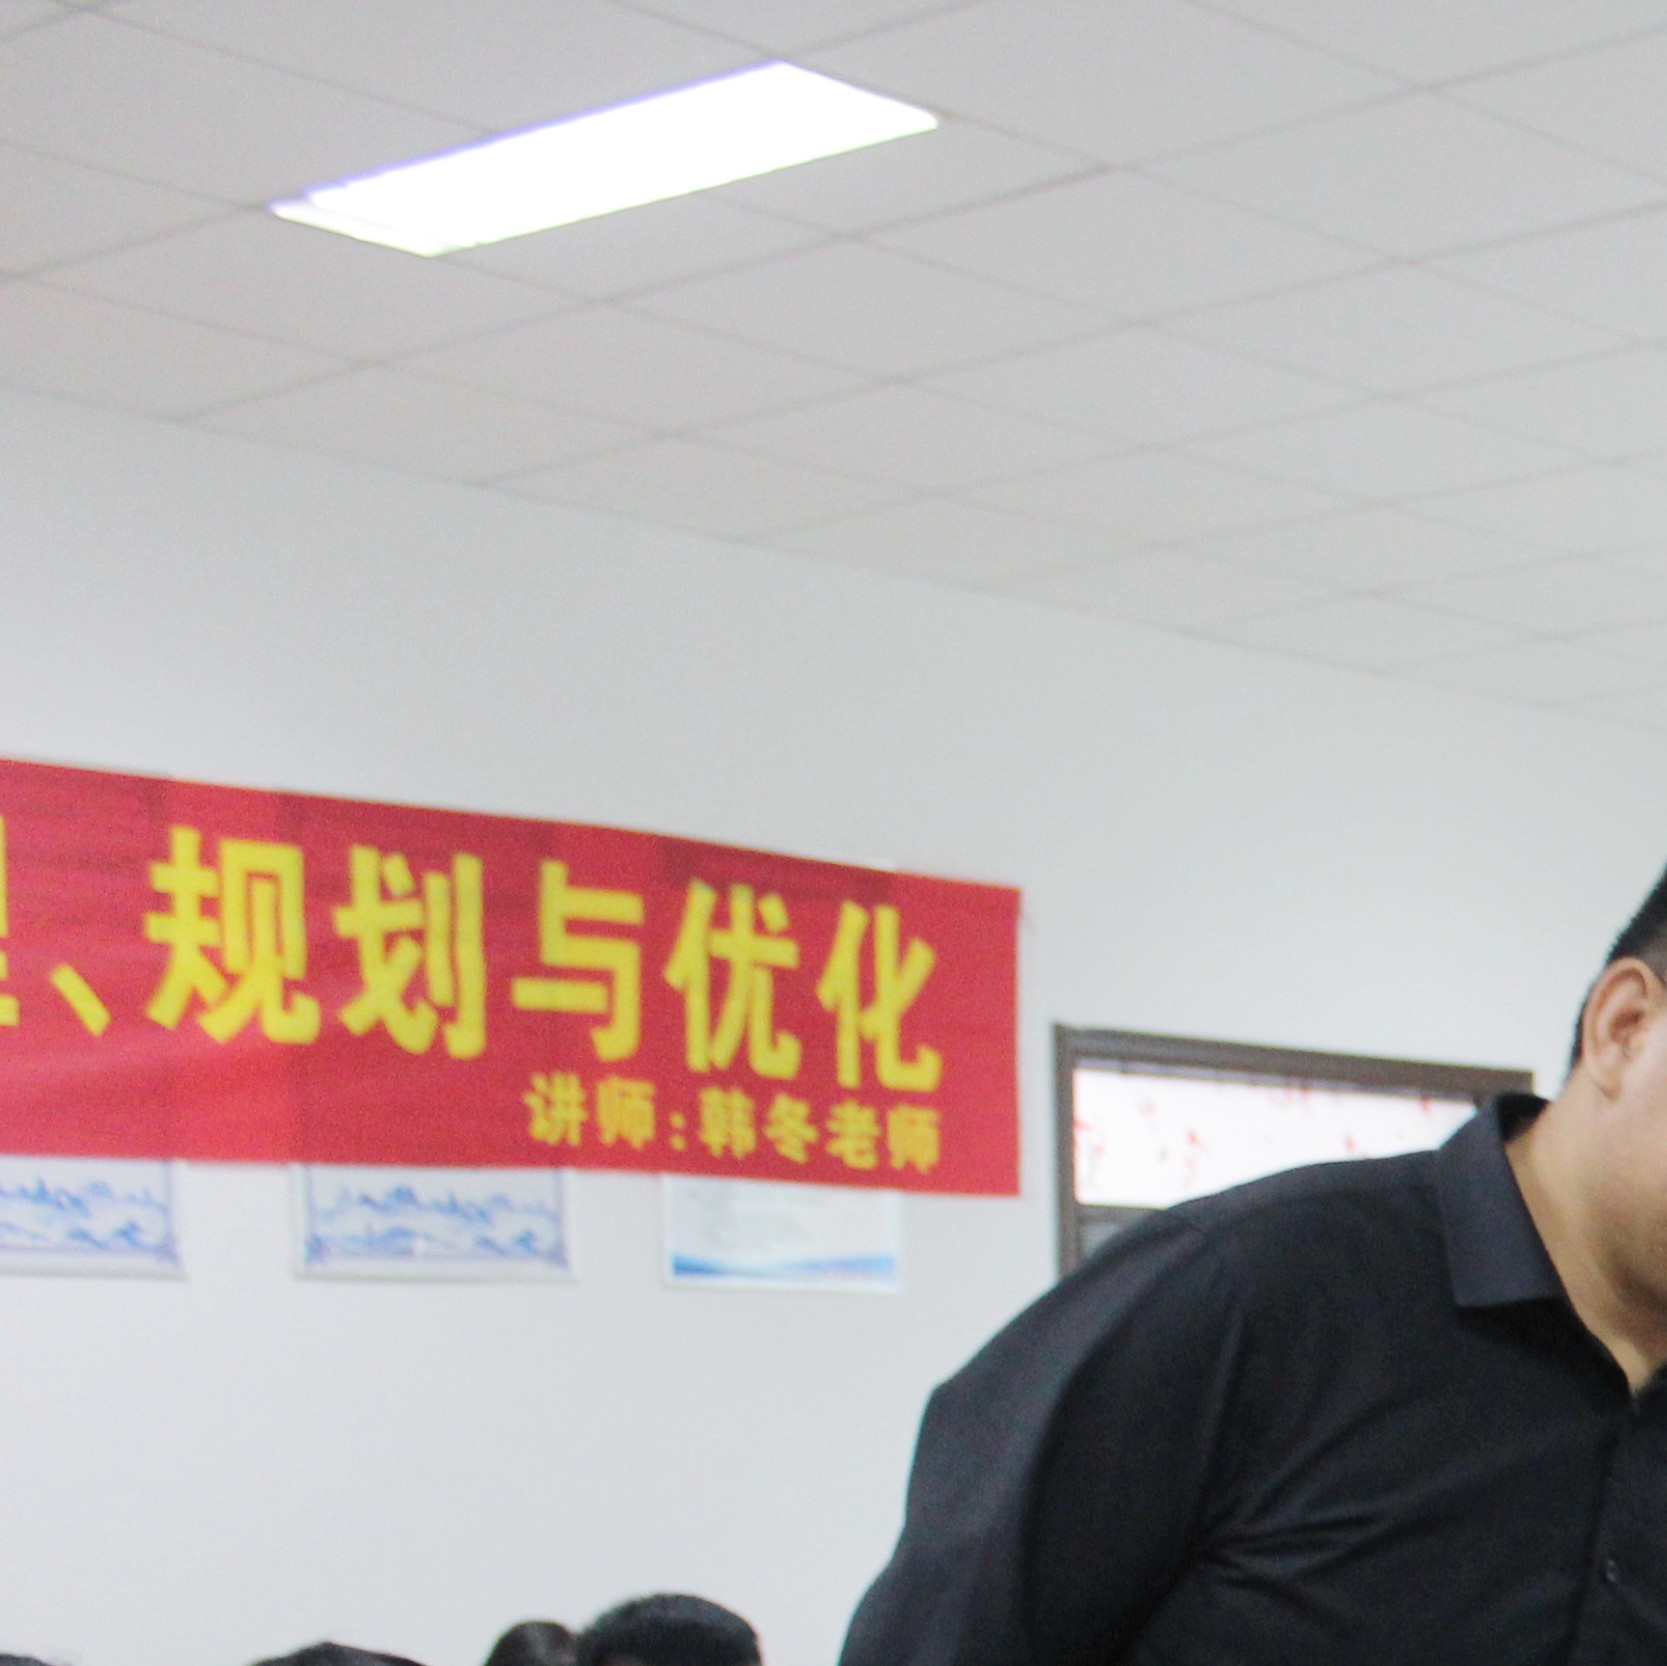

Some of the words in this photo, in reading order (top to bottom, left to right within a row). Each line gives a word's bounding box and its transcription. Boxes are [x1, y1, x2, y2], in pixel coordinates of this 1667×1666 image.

[0, 814, 943, 1092] 、规划与优化
